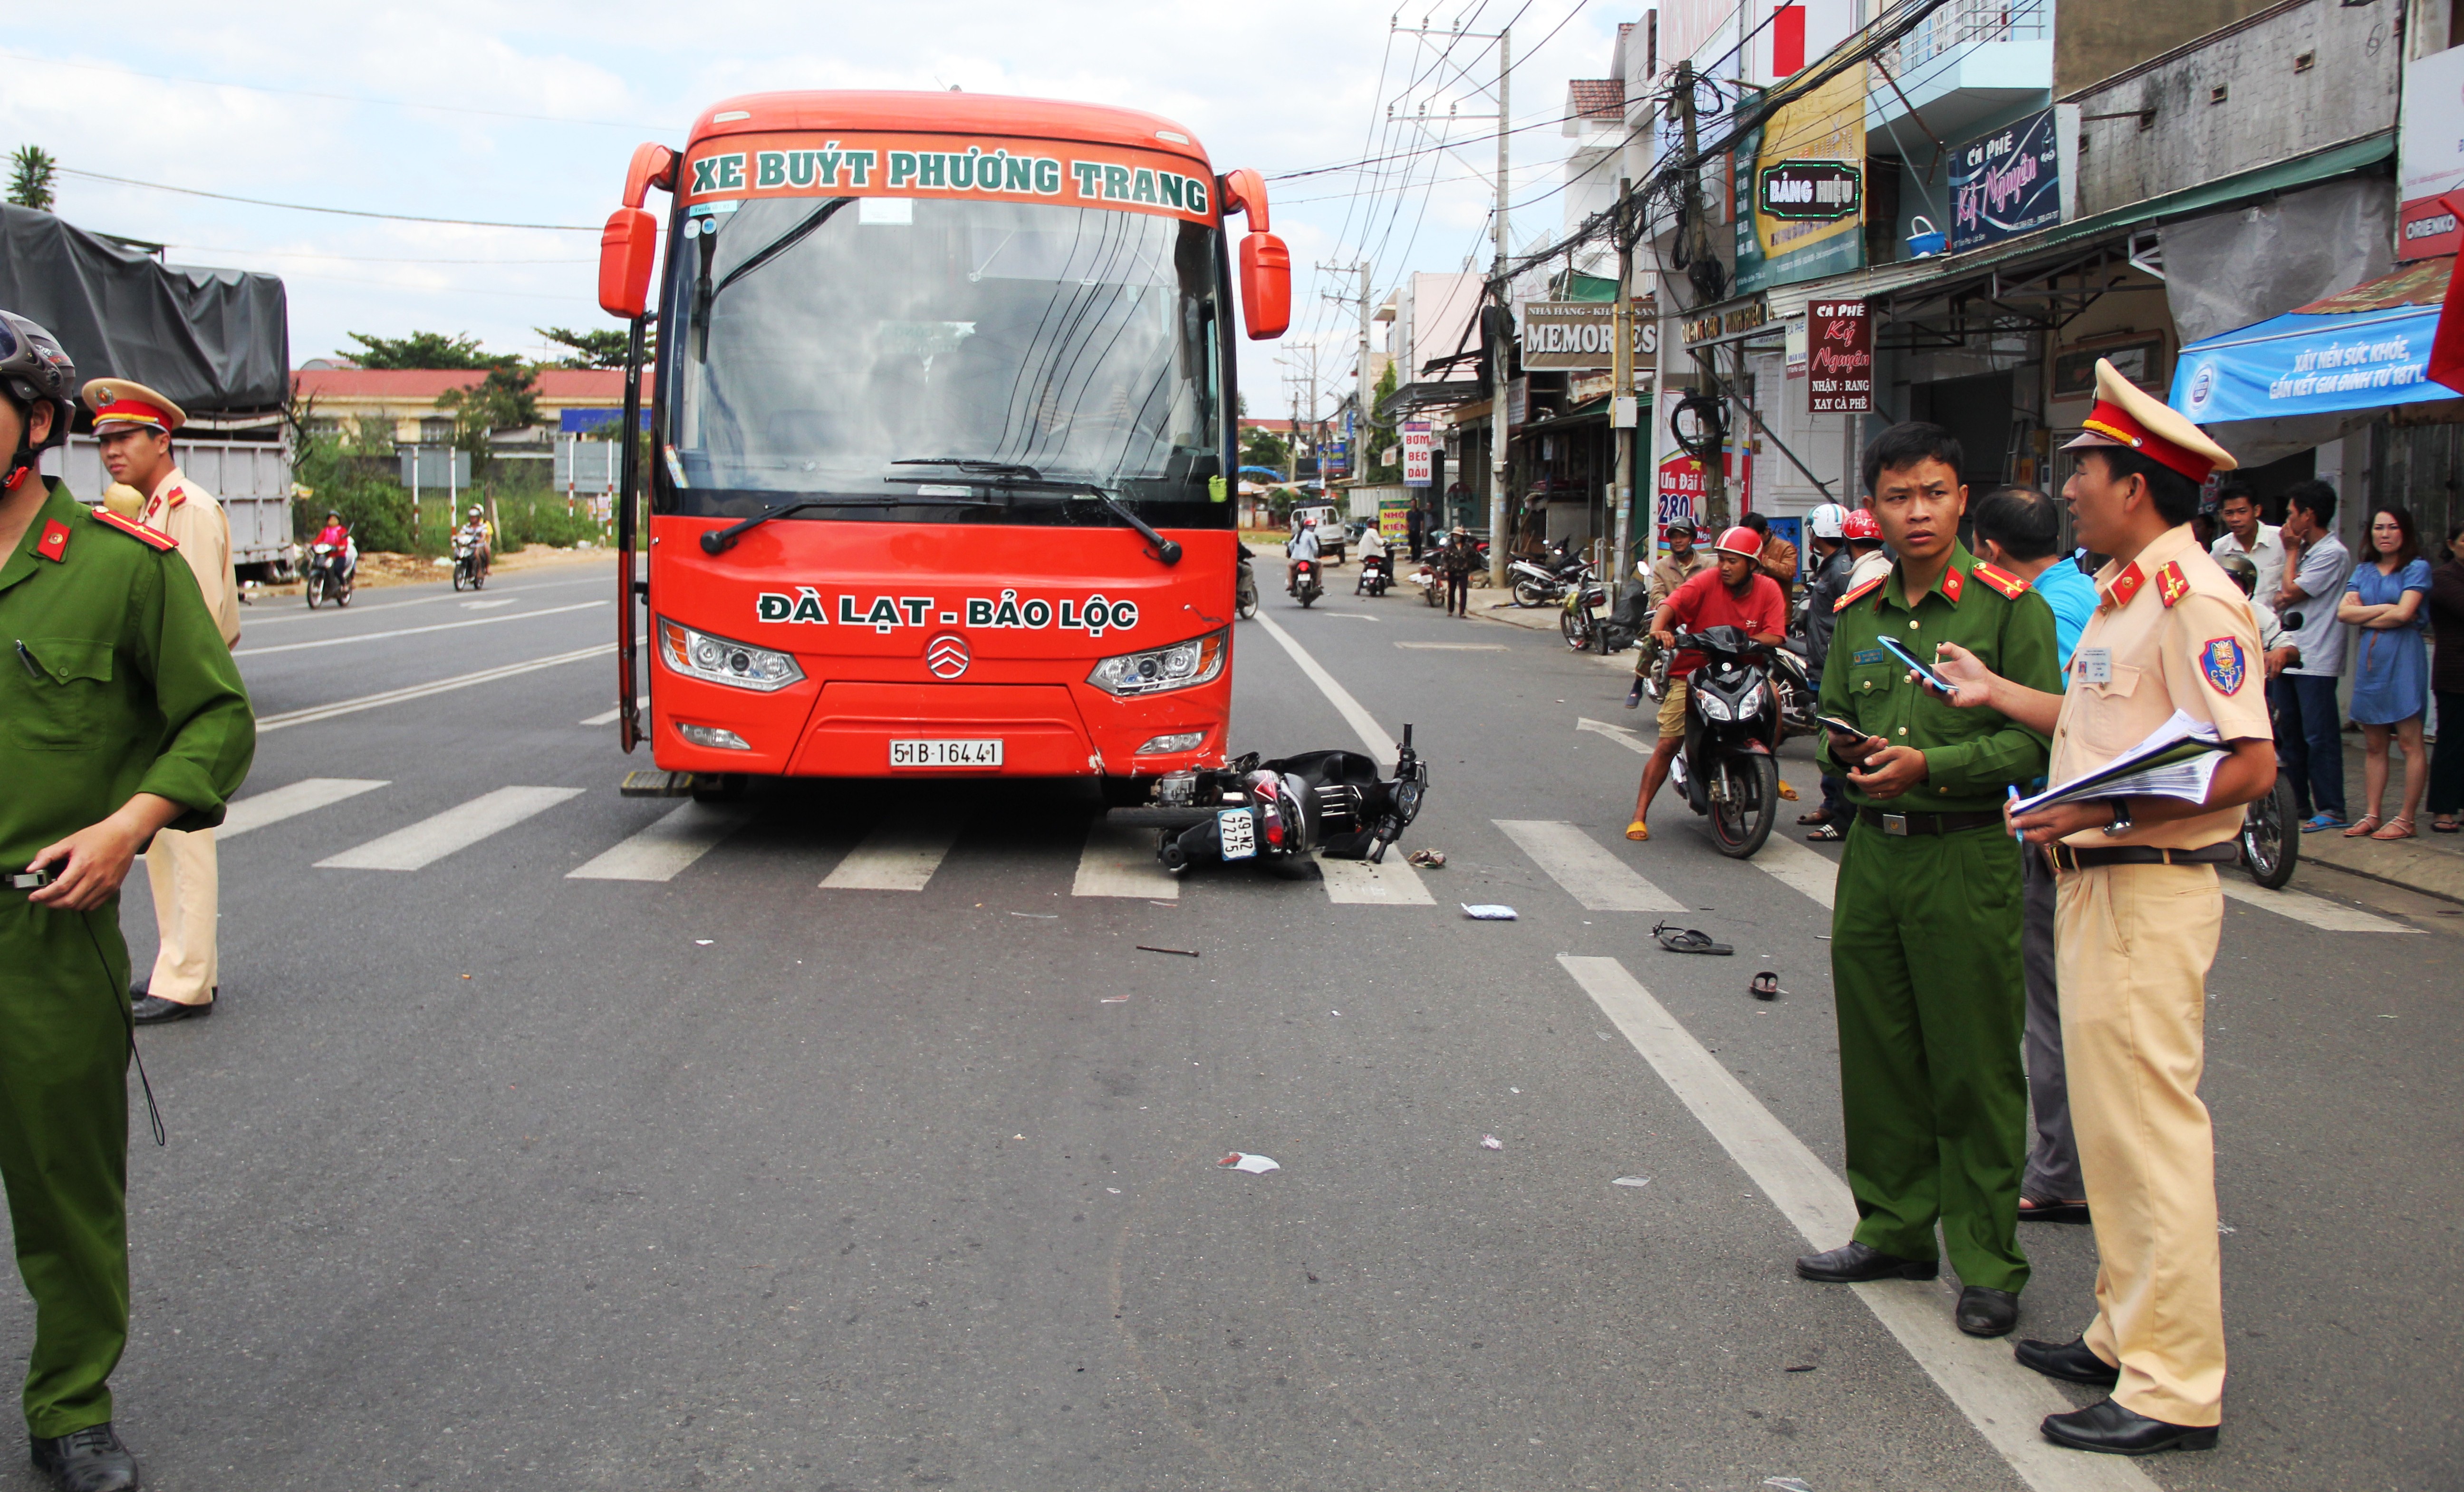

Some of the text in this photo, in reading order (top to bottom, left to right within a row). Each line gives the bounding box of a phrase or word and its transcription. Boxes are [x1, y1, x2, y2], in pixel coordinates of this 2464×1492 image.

[1986, 131, 2013, 160] PHÊ
[690, 140, 1209, 216] XE BUÝT PHƯƠNG TRANG
[1769, 172, 1813, 203] BẢNG
[1816, 174, 1853, 208] HIỆU
[1981, 152, 2037, 219] Nguyên
[1528, 306, 1552, 316] NHÀ
[1554, 306, 1585, 316] HÀNG
[1634, 308, 1655, 317] SẠN
[1817, 303, 1866, 317] CÀ PHÊ
[1526, 324, 1656, 353] MEMORES
[1811, 347, 1870, 374] Nguyên
[2294, 349, 2317, 373] XÂY
[2343, 341, 2370, 366] SỨC
[1812, 378, 1837, 393] NHẬN
[1845, 380, 1869, 392] RANG
[2292, 371, 2318, 396] KẾT
[2315, 375, 2339, 395] GIA
[1814, 395, 1867, 410] XAY CÀ PHÊ
[1406, 435, 1430, 444] BƠM
[1660, 472, 1676, 489] Ưu
[1679, 473, 1698, 491] Đãi
[1384, 510, 1407, 519] NHÔ
[757, 587, 1139, 637] ĐÀ LẠT - BẢO LỘC
[895, 743, 995, 763] 51B-164.41
[1221, 817, 1239, 852] 7275
